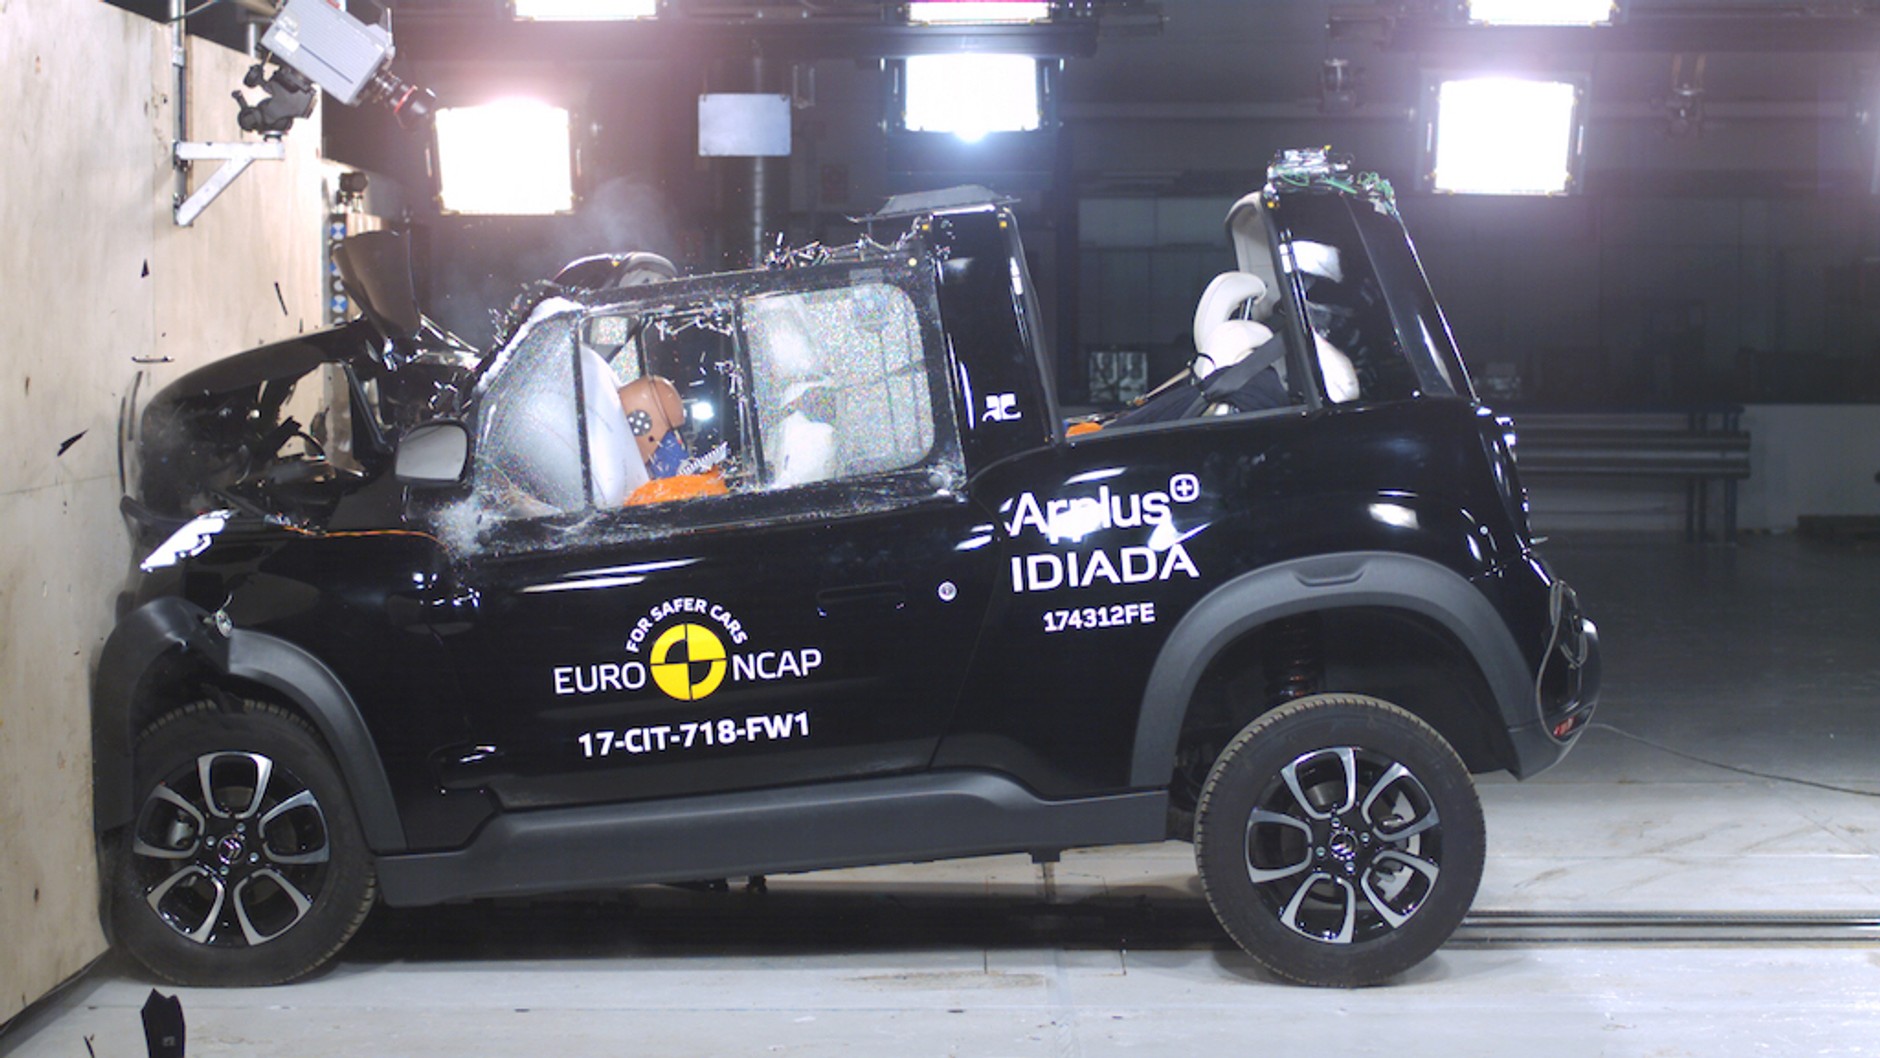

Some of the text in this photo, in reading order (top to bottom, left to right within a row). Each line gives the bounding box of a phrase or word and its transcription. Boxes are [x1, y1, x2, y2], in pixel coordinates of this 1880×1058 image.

[1011, 544, 1200, 592] IDIADA
[625, 597, 749, 653] FOR SAFER CARS
[1043, 602, 1155, 632] 174312FE
[553, 648, 822, 694] EURO NCAP
[577, 711, 810, 757] 17-CIT-718-FW1
